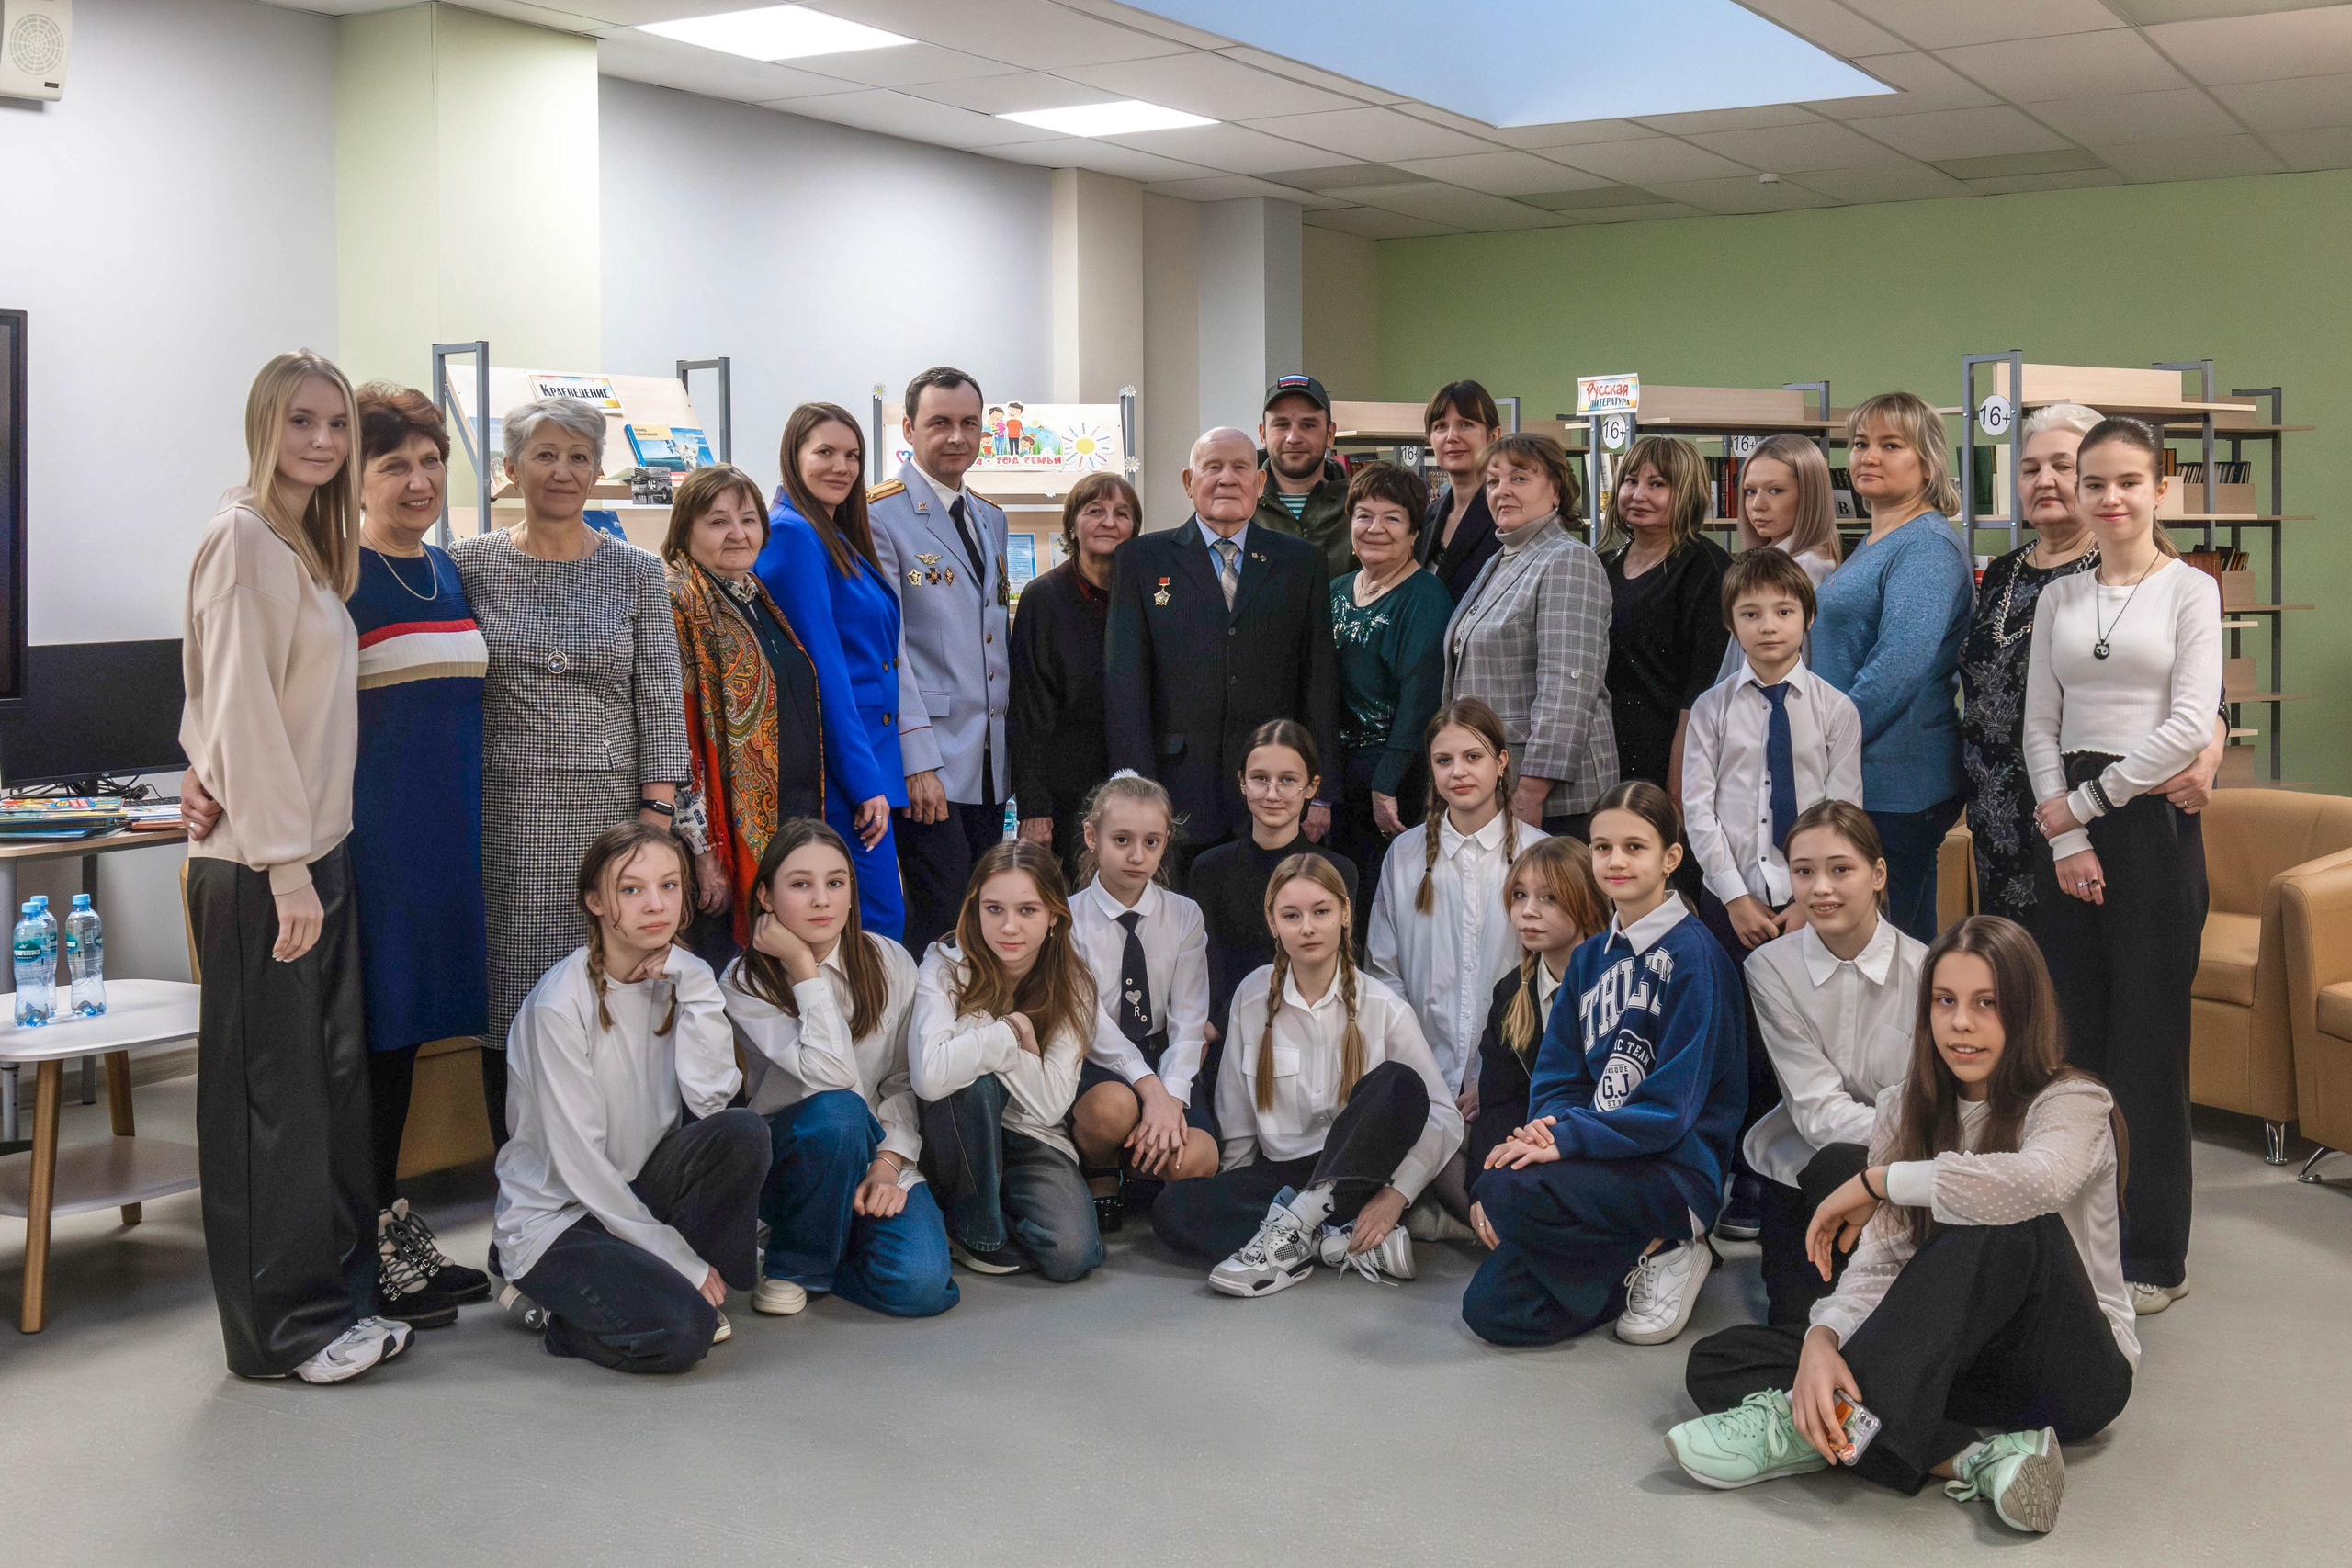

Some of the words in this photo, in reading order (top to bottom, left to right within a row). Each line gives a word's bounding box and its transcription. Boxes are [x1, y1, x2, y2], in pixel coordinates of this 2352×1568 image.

[539, 384, 610, 399] КРАЕВЕДЕНИЕ
[1587, 382, 1629, 401] Русская
[1589, 397, 1630, 408] ЛИТЕРАТУРА
[1980, 405, 2011, 426] 16+
[1603, 420, 1625, 440] 16+
[1734, 435, 1755, 451] 16+
[996, 457, 1020, 465] ГОД
[1024, 457, 1061, 465] СЕМЬИ
[1626, 1042, 1651, 1066] TEAM
